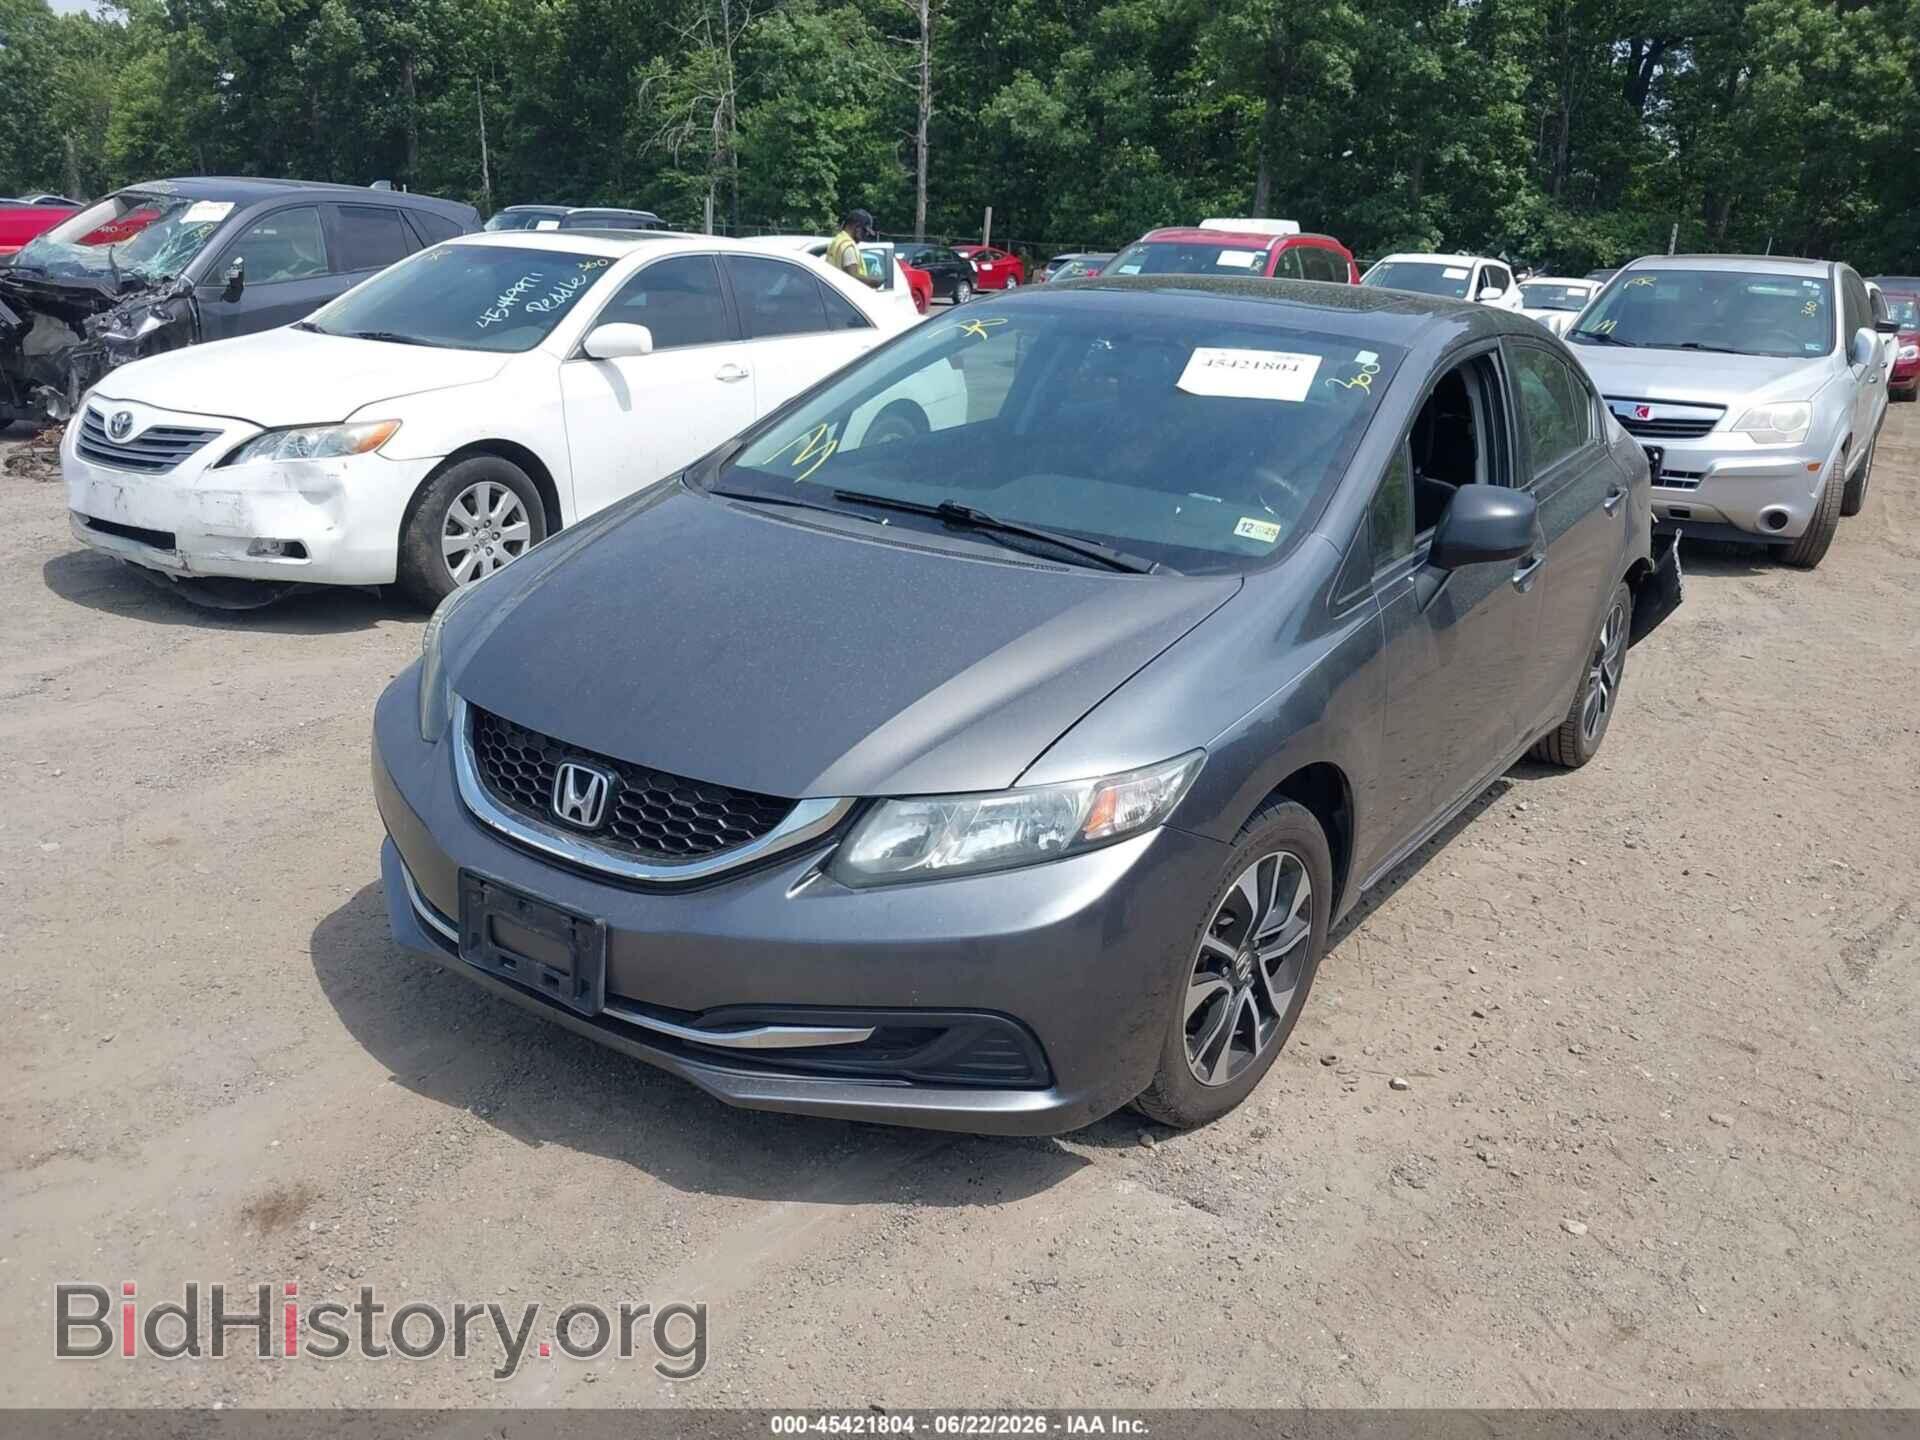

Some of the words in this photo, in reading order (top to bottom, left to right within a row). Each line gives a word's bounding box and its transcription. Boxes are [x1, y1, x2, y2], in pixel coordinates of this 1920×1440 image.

[524, 274, 587, 313] Peddle
[1201, 358, 1300, 372] 45421804
[1240, 521, 1254, 533] 12
